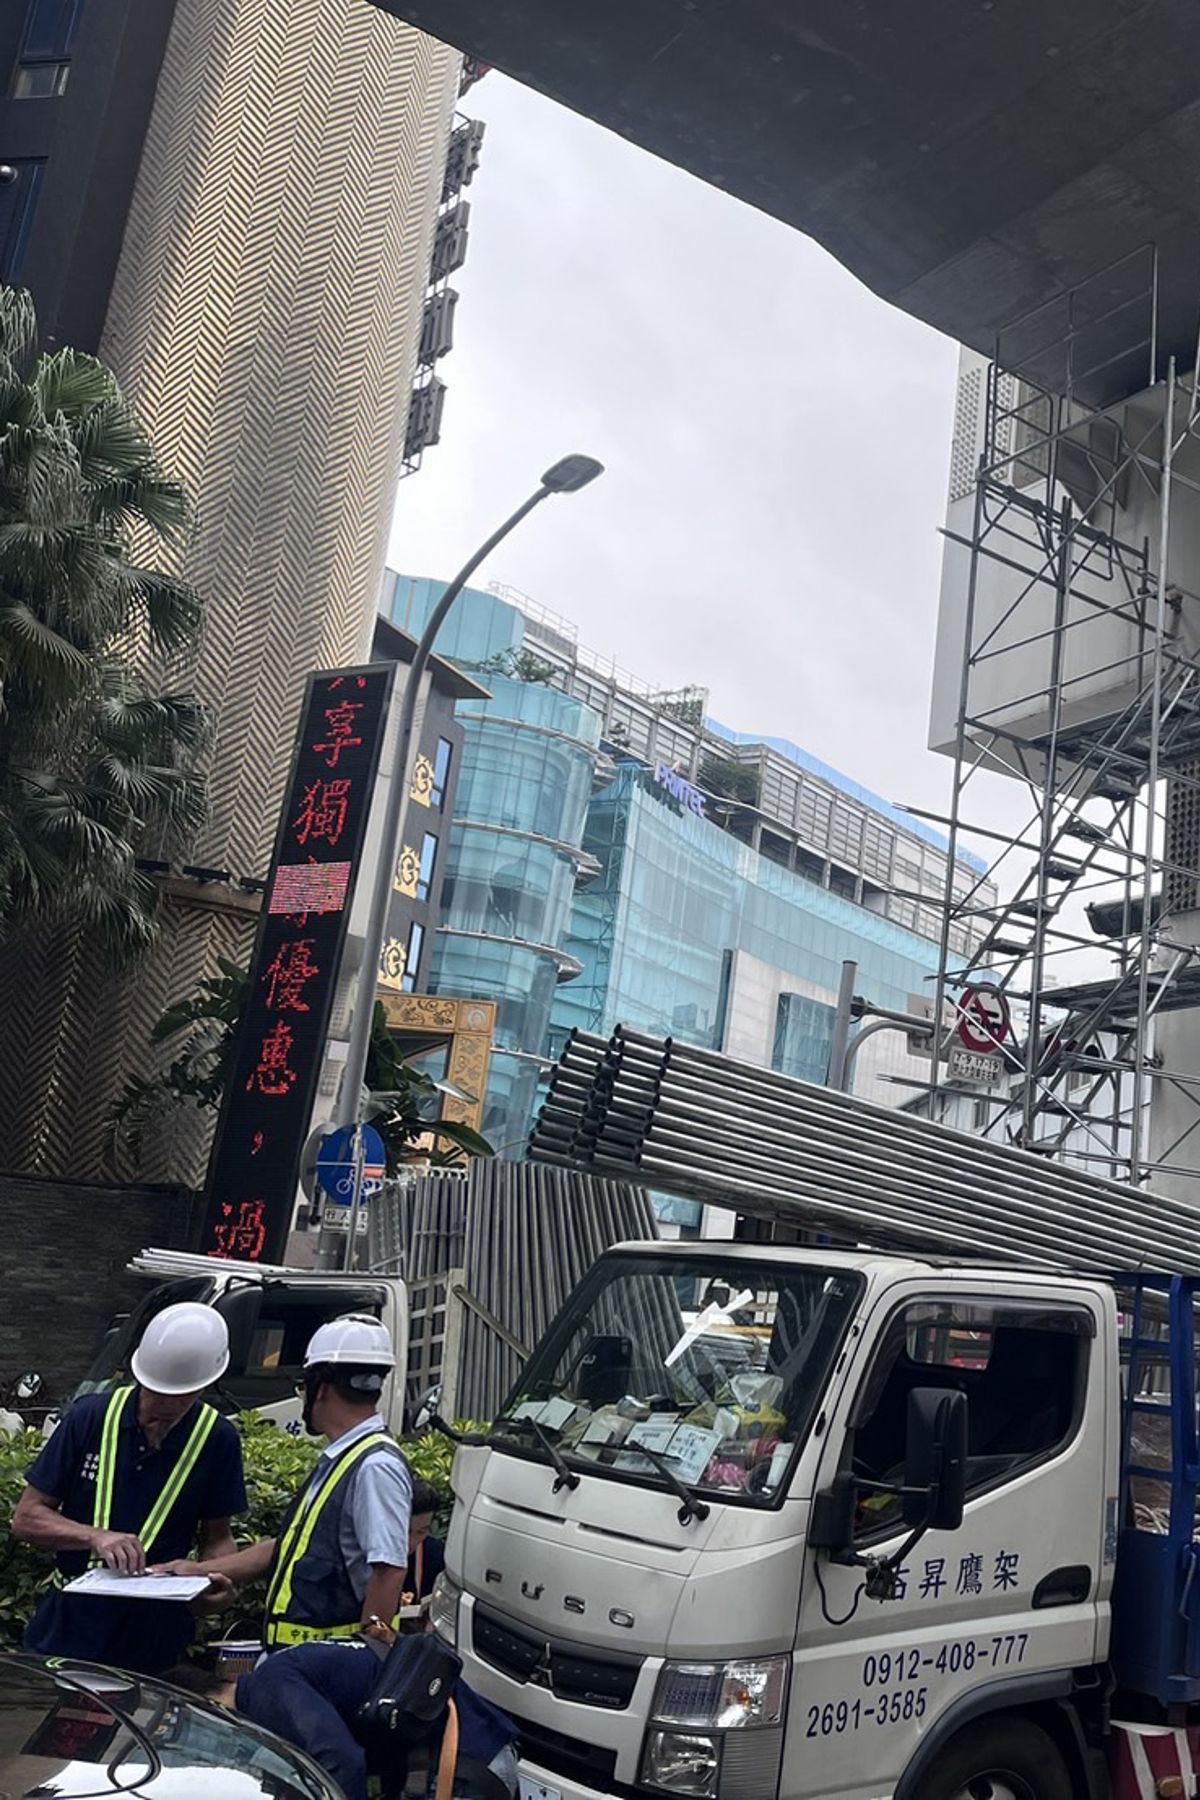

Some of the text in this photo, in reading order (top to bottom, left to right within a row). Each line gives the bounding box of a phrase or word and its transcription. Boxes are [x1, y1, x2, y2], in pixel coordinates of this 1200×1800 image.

[485, 1567, 635, 1629] FUSO
[862, 1633, 1029, 1688] 0912-408-777
[805, 1687, 928, 1739] 2691-3585
